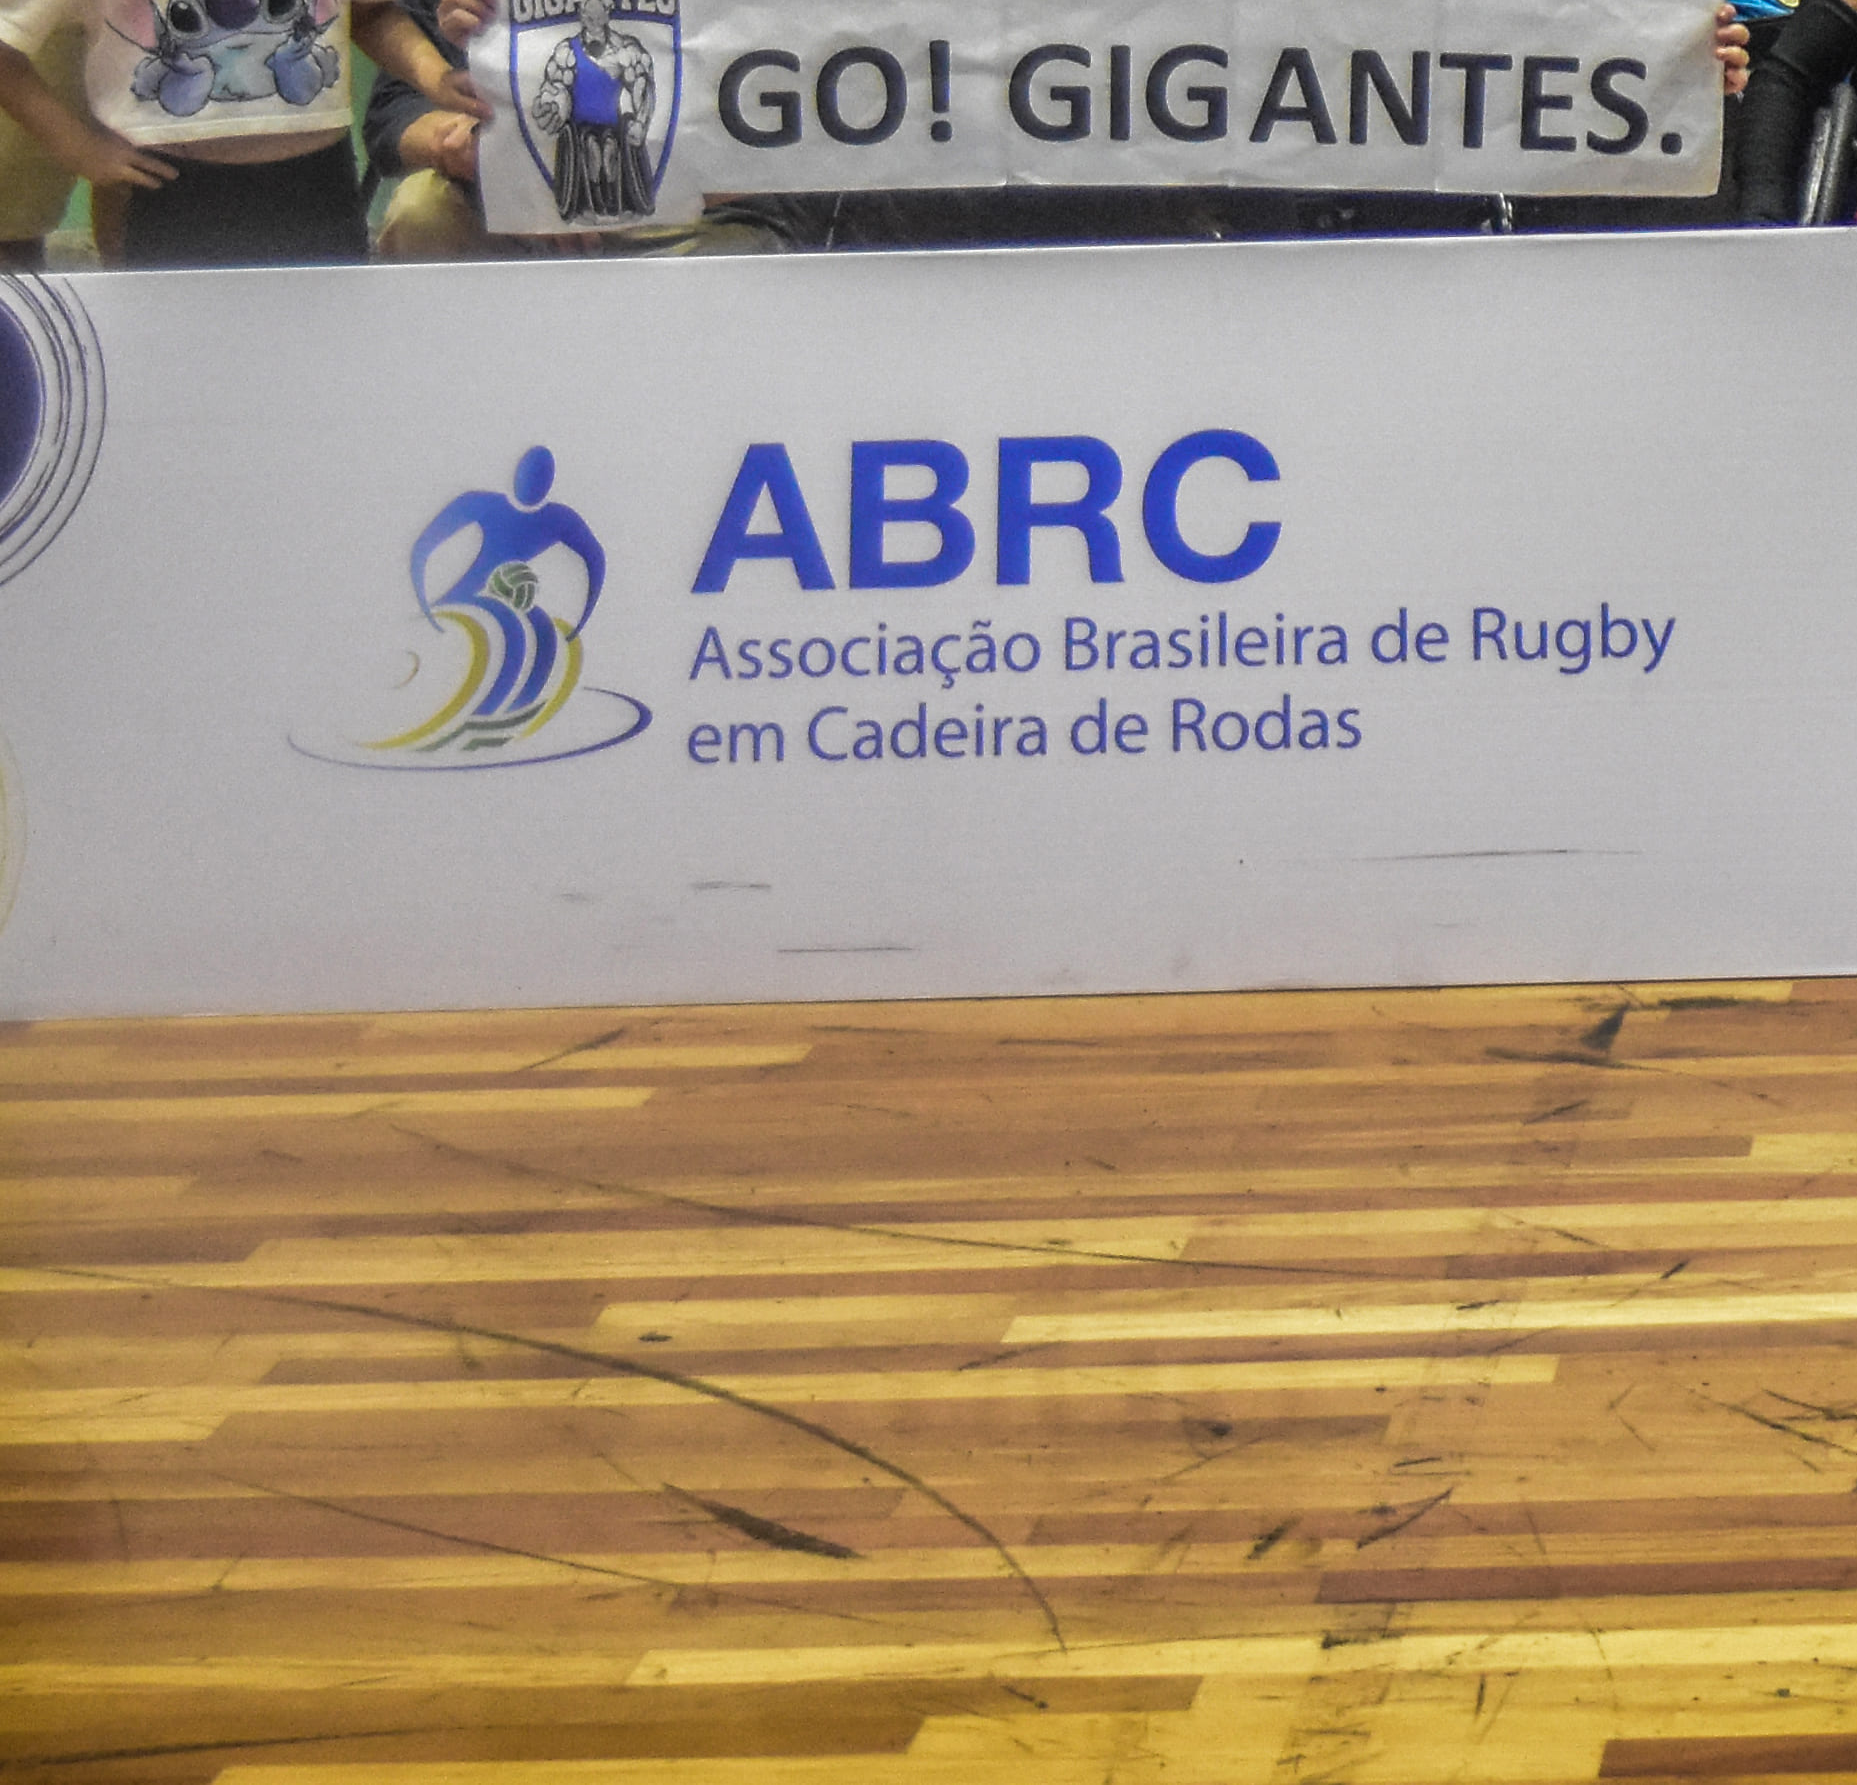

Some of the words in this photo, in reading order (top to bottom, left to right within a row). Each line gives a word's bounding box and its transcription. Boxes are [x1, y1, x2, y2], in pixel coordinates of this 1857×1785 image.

[716, 38, 952, 149] GO!
[1007, 41, 1684, 157] GIGANTES.
[690, 428, 1283, 594] ABRC
[689, 621, 1041, 689] Associação
[1064, 609, 1350, 673] Brasileira
[1370, 606, 1449, 664] de
[1473, 602, 1676, 676] Rugby
[687, 715, 785, 765] em
[808, 701, 1047, 763] Cadeira
[1069, 698, 1150, 756] de
[1172, 692, 1362, 752] Rodas
